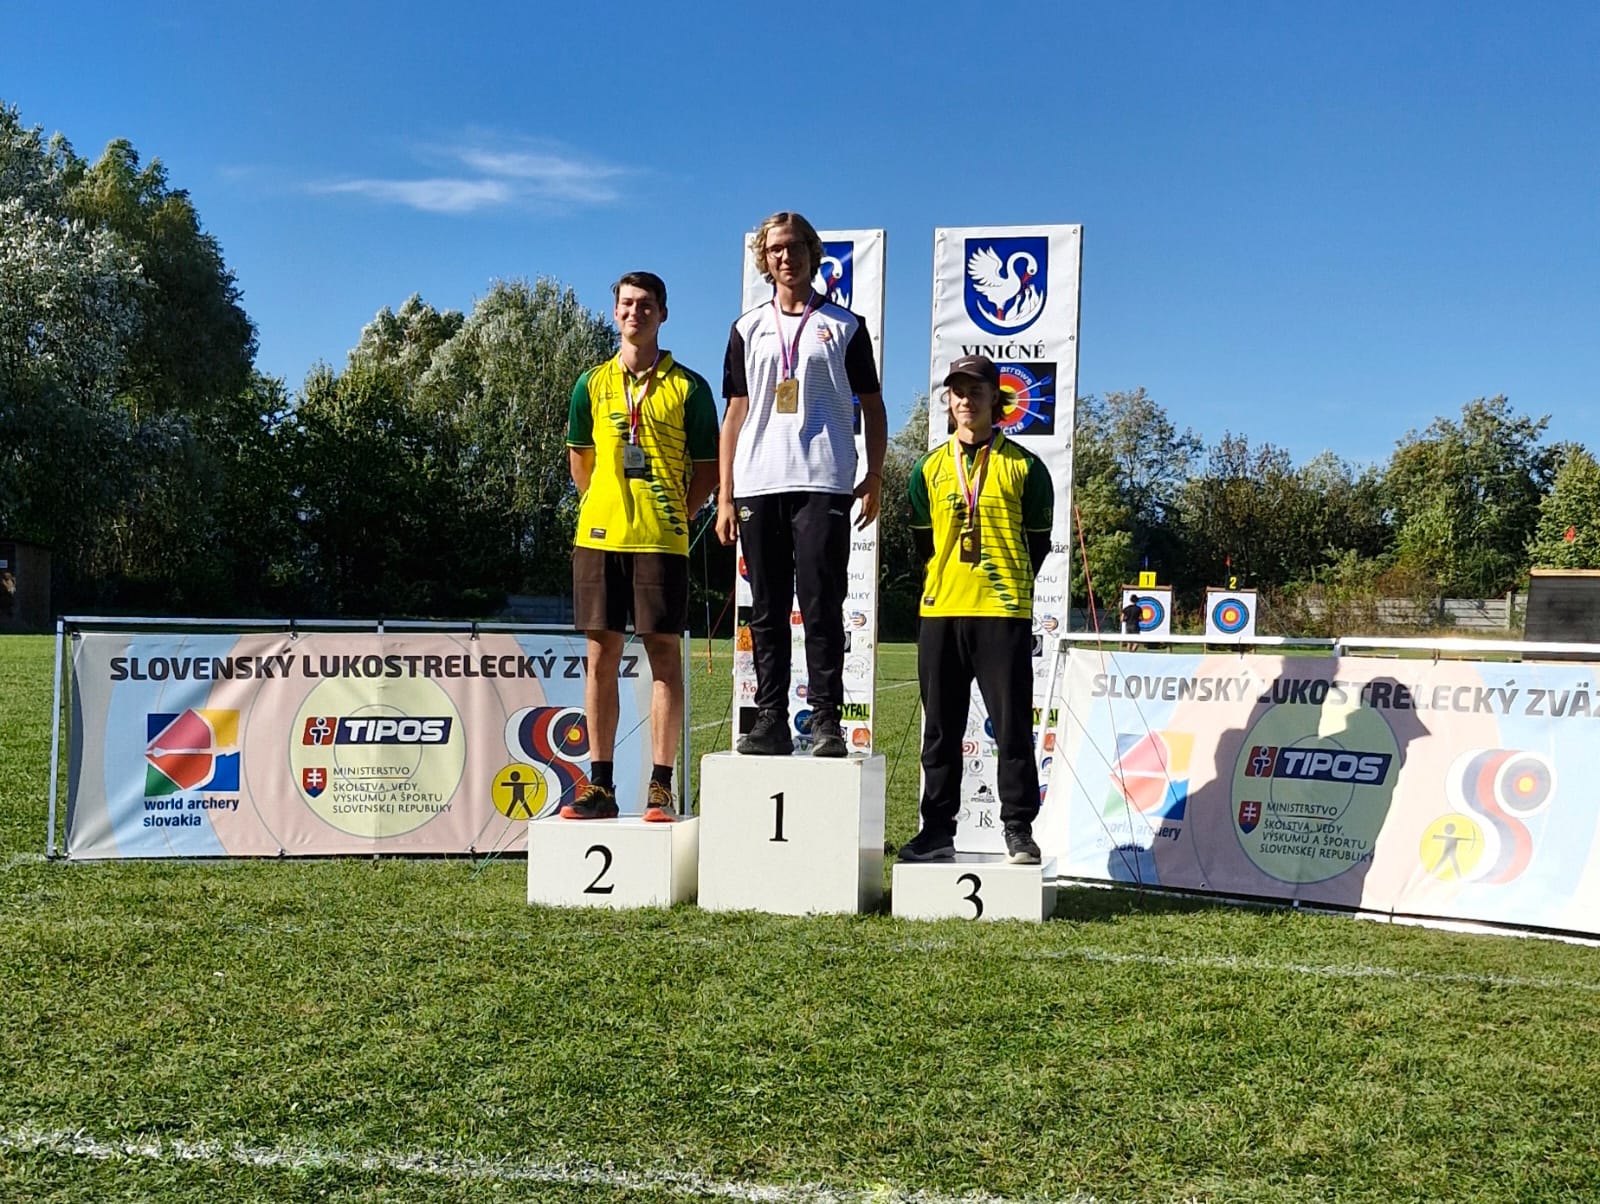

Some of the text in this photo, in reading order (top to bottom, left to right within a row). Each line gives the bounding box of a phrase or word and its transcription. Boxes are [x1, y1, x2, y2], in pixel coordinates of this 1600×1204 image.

[961, 340, 1045, 359] VINIČNÉ
[1000, 366, 1033, 386] arrows
[1229, 576, 1237, 589] 2
[110, 647, 639, 681] SLOVENSKÝ LUKOSTRELECKÝ ZZ
[1091, 670, 1250, 702] SLOVENSKÝ
[1258, 677, 1520, 715] LUKOSTRELECKÝ
[344, 719, 445, 742] TIPOS
[333, 767, 410, 776] MINISTERSTVO
[1284, 751, 1383, 781] TIPOS
[144, 796, 240, 812] world archery
[333, 792, 443, 802] VÝSKUMU A ŠPORTU
[333, 803, 452, 814] SLOVENSKEJ REPUBLIKY
[769, 791, 789, 842] 1
[1267, 802, 1338, 816] MINISTERSTVO
[143, 813, 202, 828] slovakia
[1262, 830, 1367, 850] VÝSKUMU A ŠPORTU
[1259, 843, 1316, 859] SLOVENSKEJ
[582, 844, 615, 894] 2
[956, 873, 984, 921] 3
